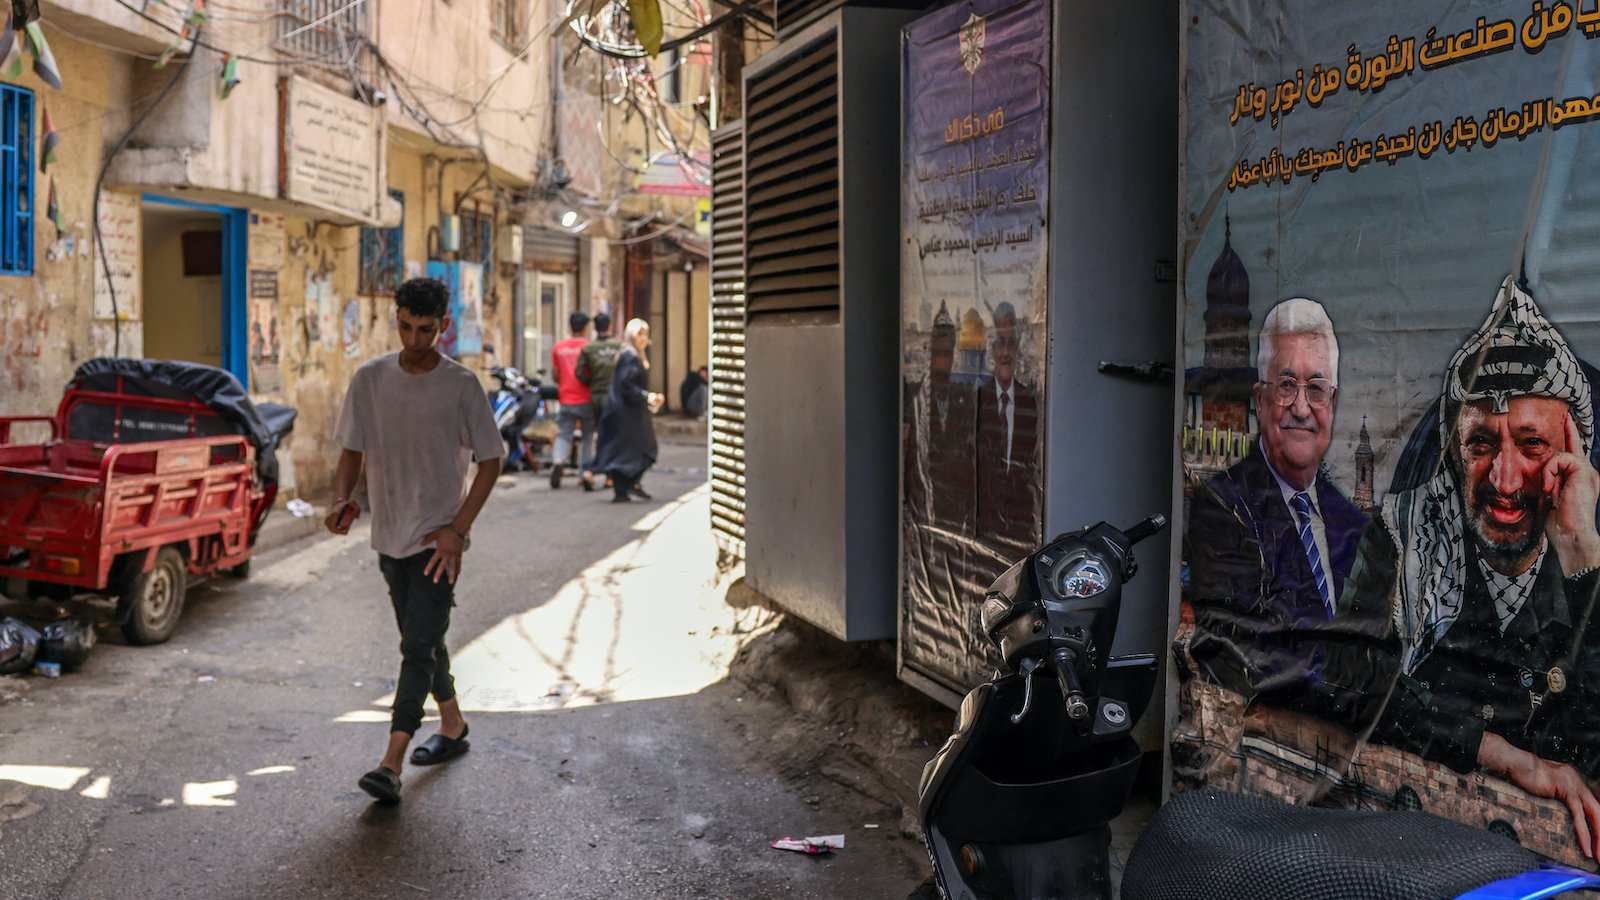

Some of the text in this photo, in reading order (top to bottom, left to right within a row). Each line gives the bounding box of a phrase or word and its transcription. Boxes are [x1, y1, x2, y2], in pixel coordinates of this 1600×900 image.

[1307, 64, 1340, 104] من
[1231, 84, 1266, 124] ونار
[1482, 102, 1544, 143] الزمان
[944, 106, 1005, 144] في ذكراك
[1419, 122, 1442, 156] لن
[1260, 148, 1278, 183] أبا
[1280, 155, 1294, 182] يا
[1347, 139, 1372, 170] عن
[918, 223, 1033, 261] السيد الرئيس محمود عباس
